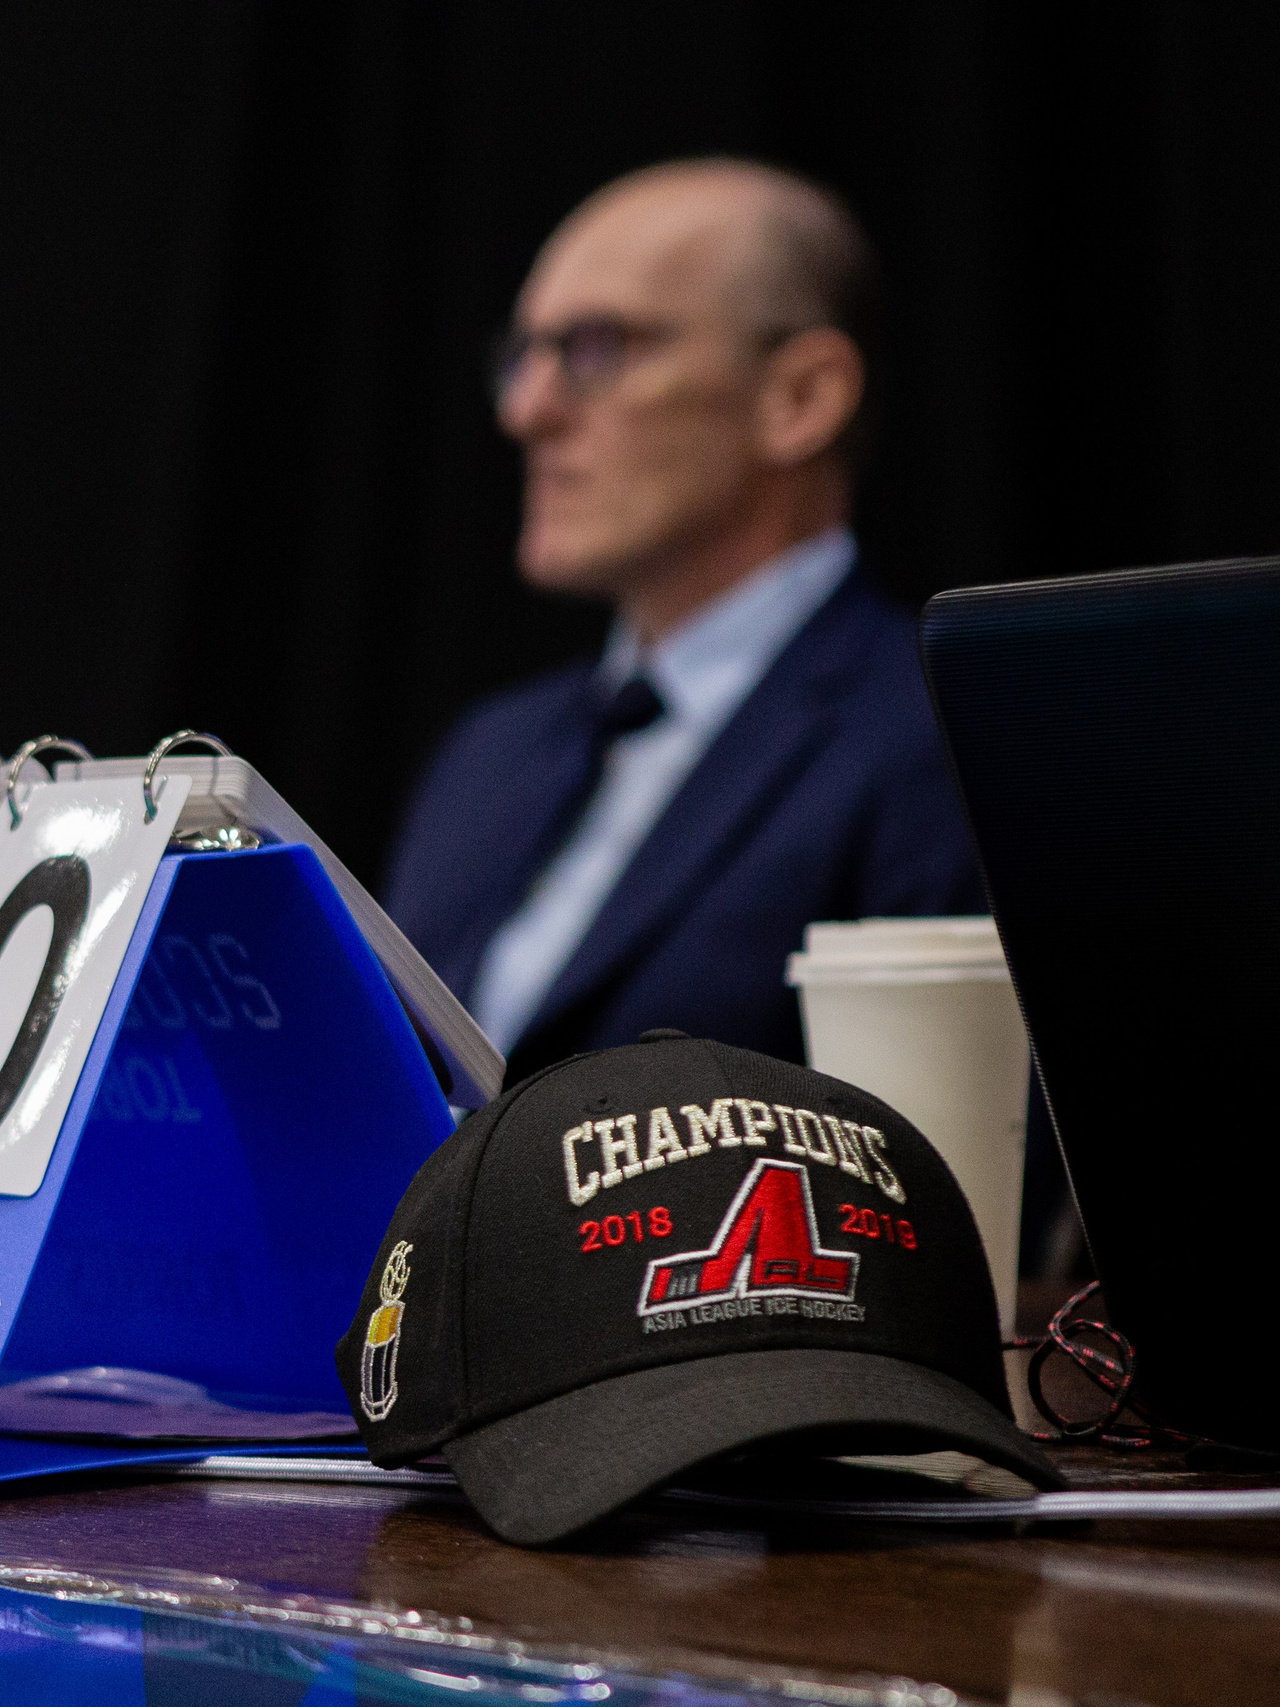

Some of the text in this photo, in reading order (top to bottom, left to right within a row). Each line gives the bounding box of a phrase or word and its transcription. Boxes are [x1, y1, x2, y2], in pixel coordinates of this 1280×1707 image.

[121, 934, 282, 1030] SCO
[563, 1098, 907, 1207] CHAMPIONS
[578, 1206, 674, 1253] 2018
[642, 1297, 866, 1334] ASIA LEAGUE ICE HOCKEY
